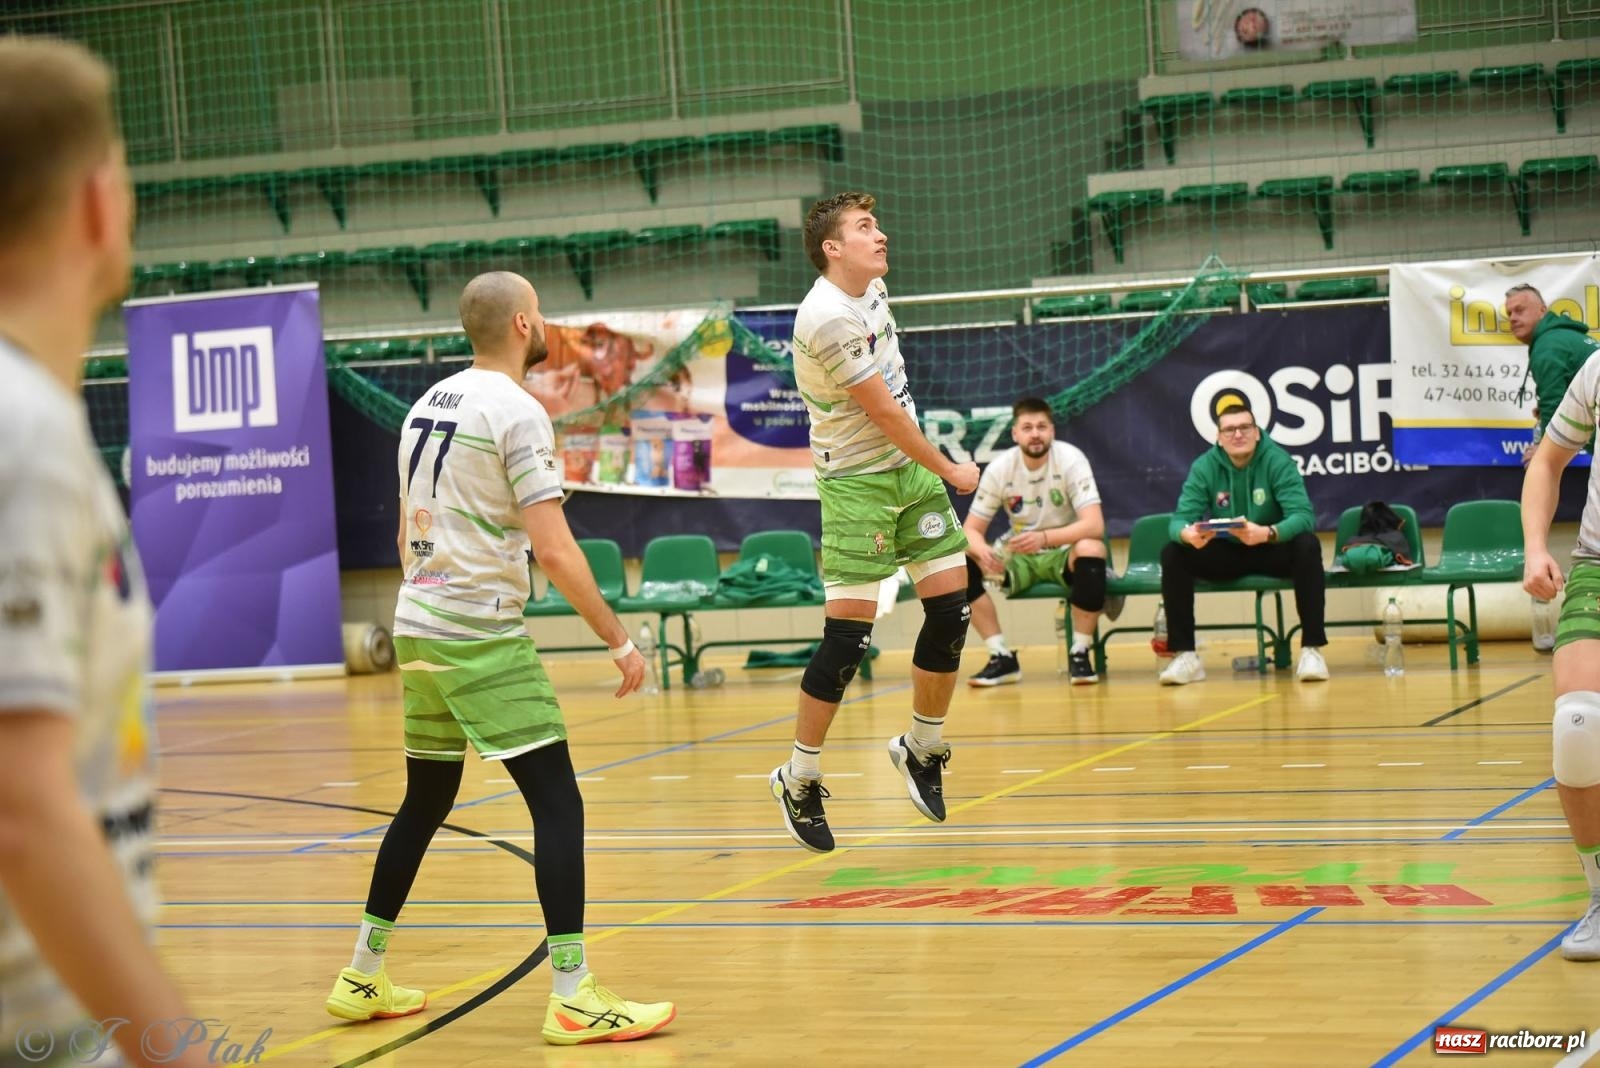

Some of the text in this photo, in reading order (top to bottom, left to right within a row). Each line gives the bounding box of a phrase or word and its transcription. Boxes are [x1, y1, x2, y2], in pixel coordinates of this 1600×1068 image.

[176, 328, 274, 431] bmp
[1411, 362, 1437, 378] tel.
[1441, 364, 1459, 378] 32
[1464, 364, 1494, 378] 414
[1500, 364, 1520, 378] 92
[427, 390, 464, 410] KANIA
[1424, 387, 1482, 402] 47-400
[146, 446, 310, 477] budujemy możliwości
[407, 417, 458, 498] 77
[1290, 443, 1429, 476] RACIBÓ
[176, 473, 282, 503] porozumienia
[764, 884, 1496, 916] RAFAKO
